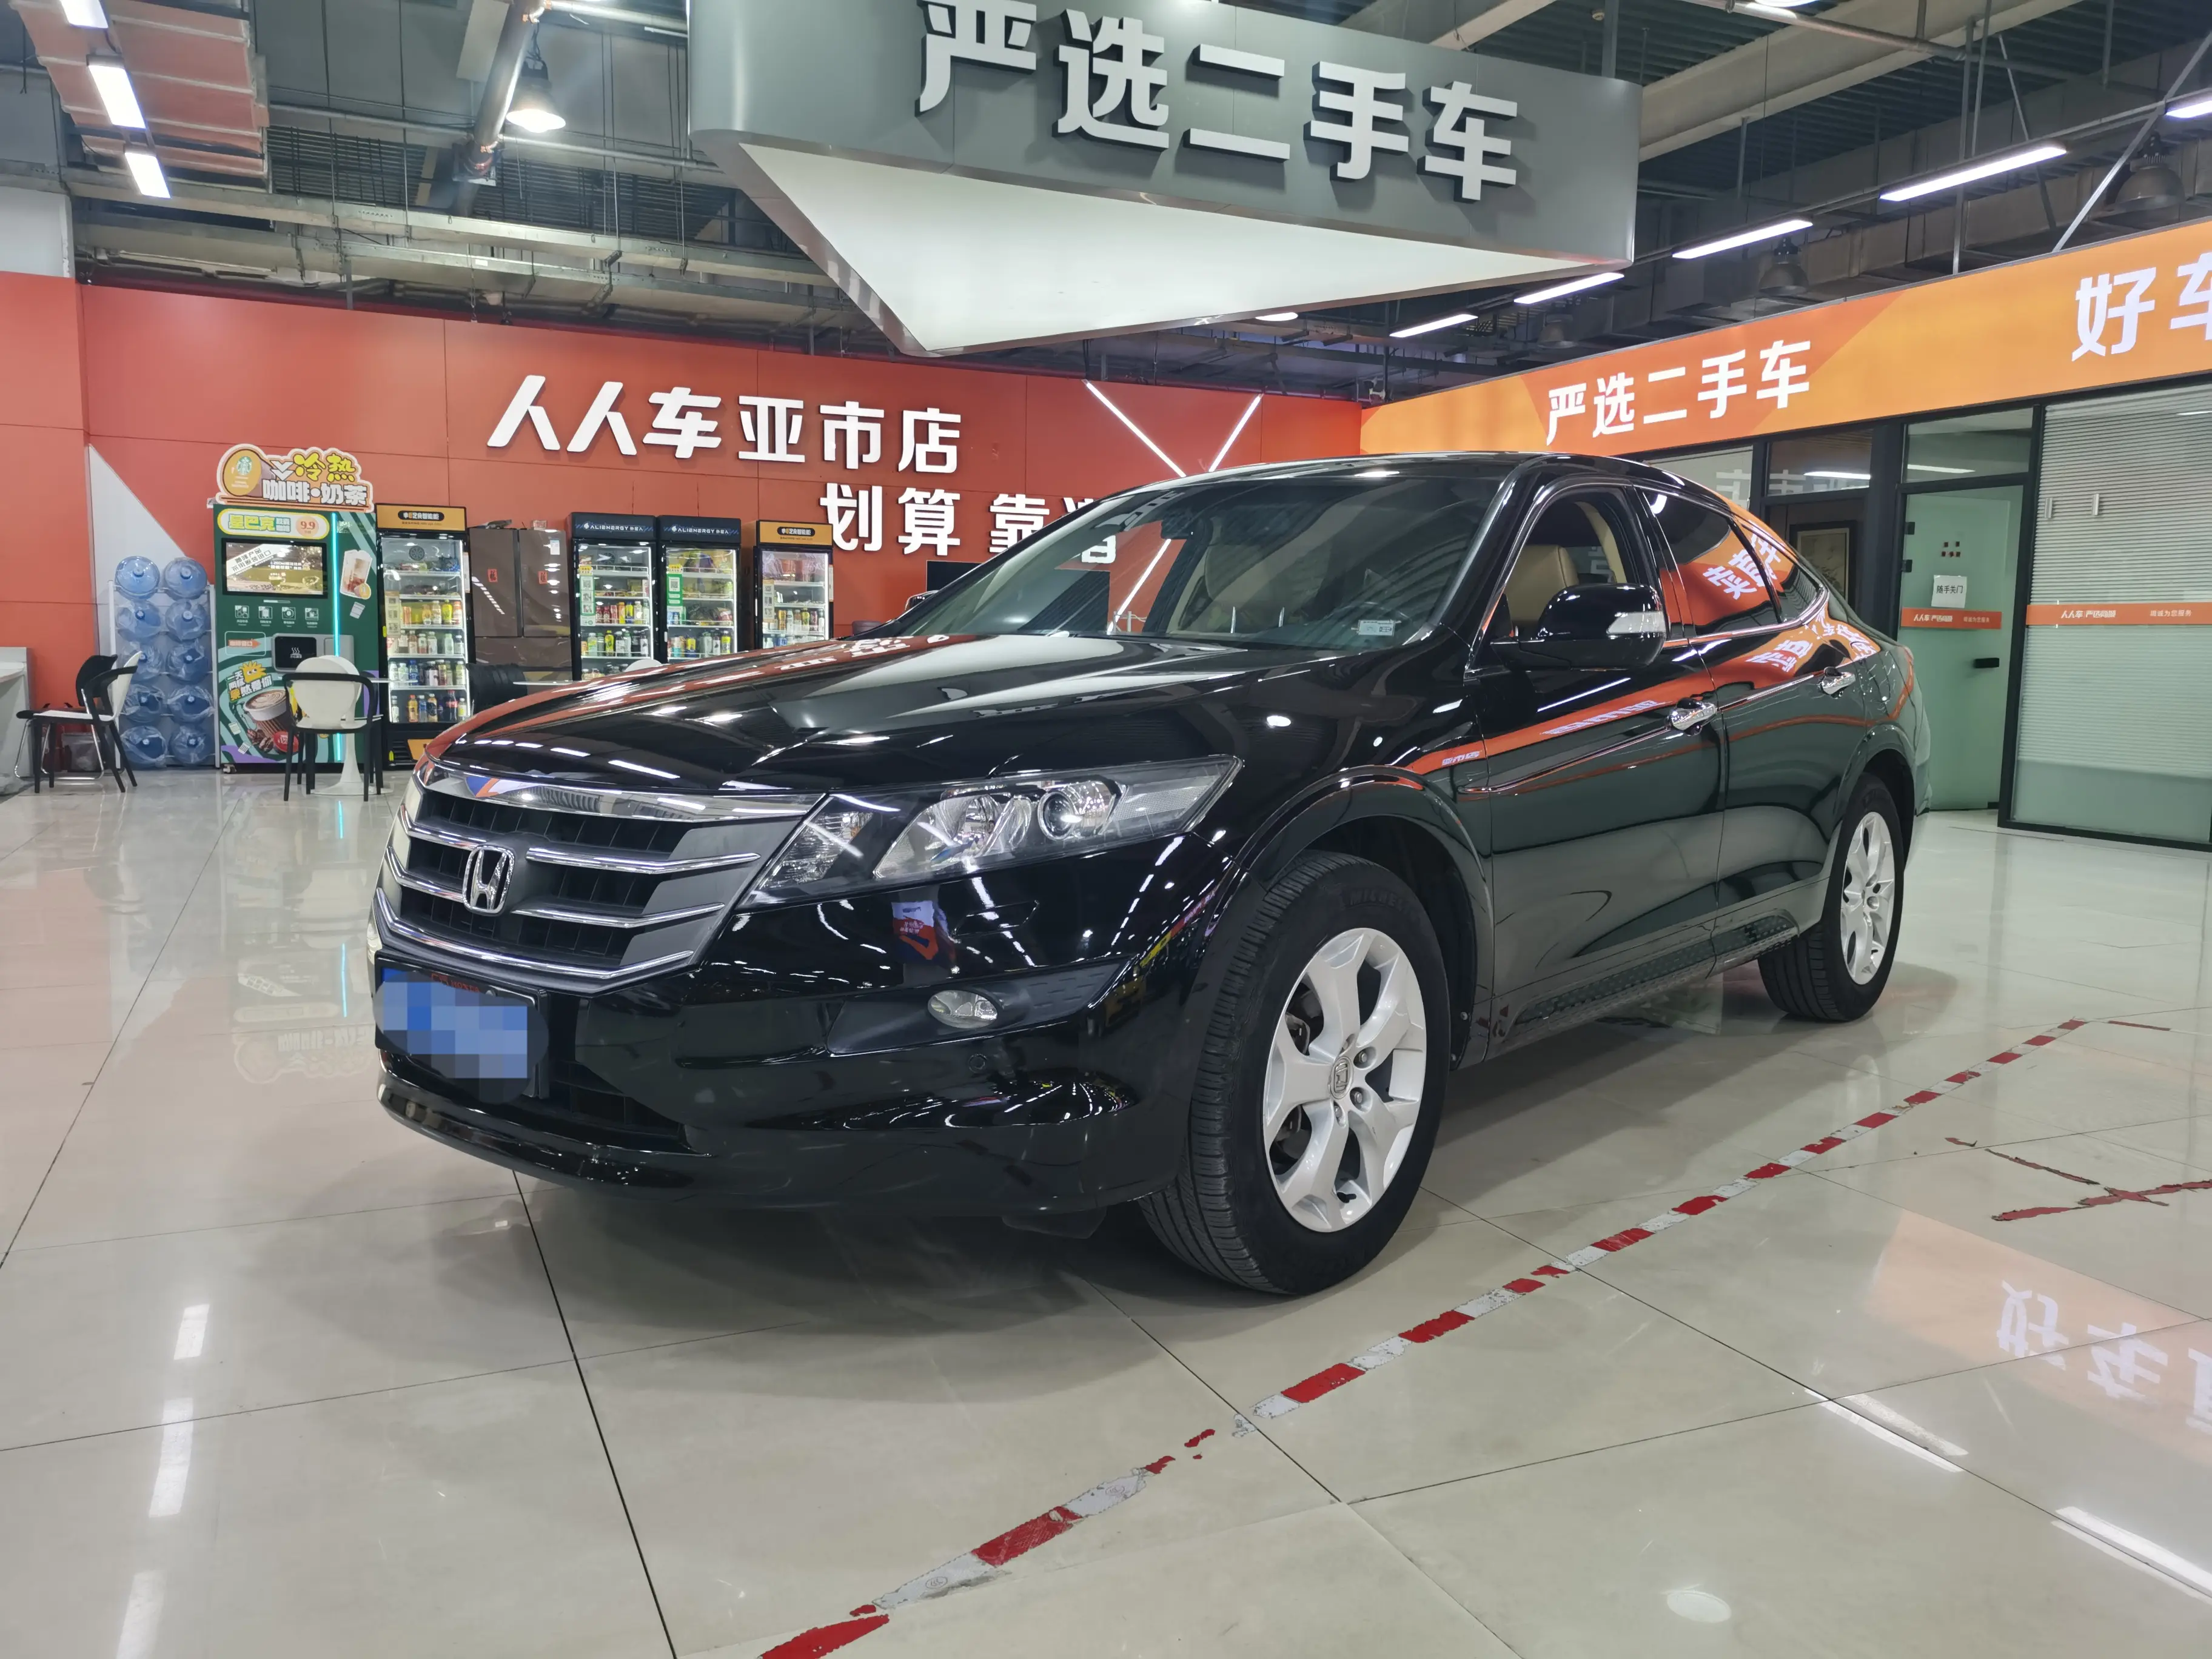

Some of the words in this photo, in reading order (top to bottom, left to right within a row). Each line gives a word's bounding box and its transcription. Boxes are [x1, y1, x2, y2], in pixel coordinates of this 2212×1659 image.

[916, 0, 1518, 201] 严选二手车
[487, 375, 961, 474] 人人车亚市店
[1547, 341, 1811, 445] 严选二手车
[293, 452, 356, 482] 冷热
[820, 483, 960, 556] 划算
[1936, 585, 1963, 594] 随手关门
[2061, 610, 2083, 618] 人人车
